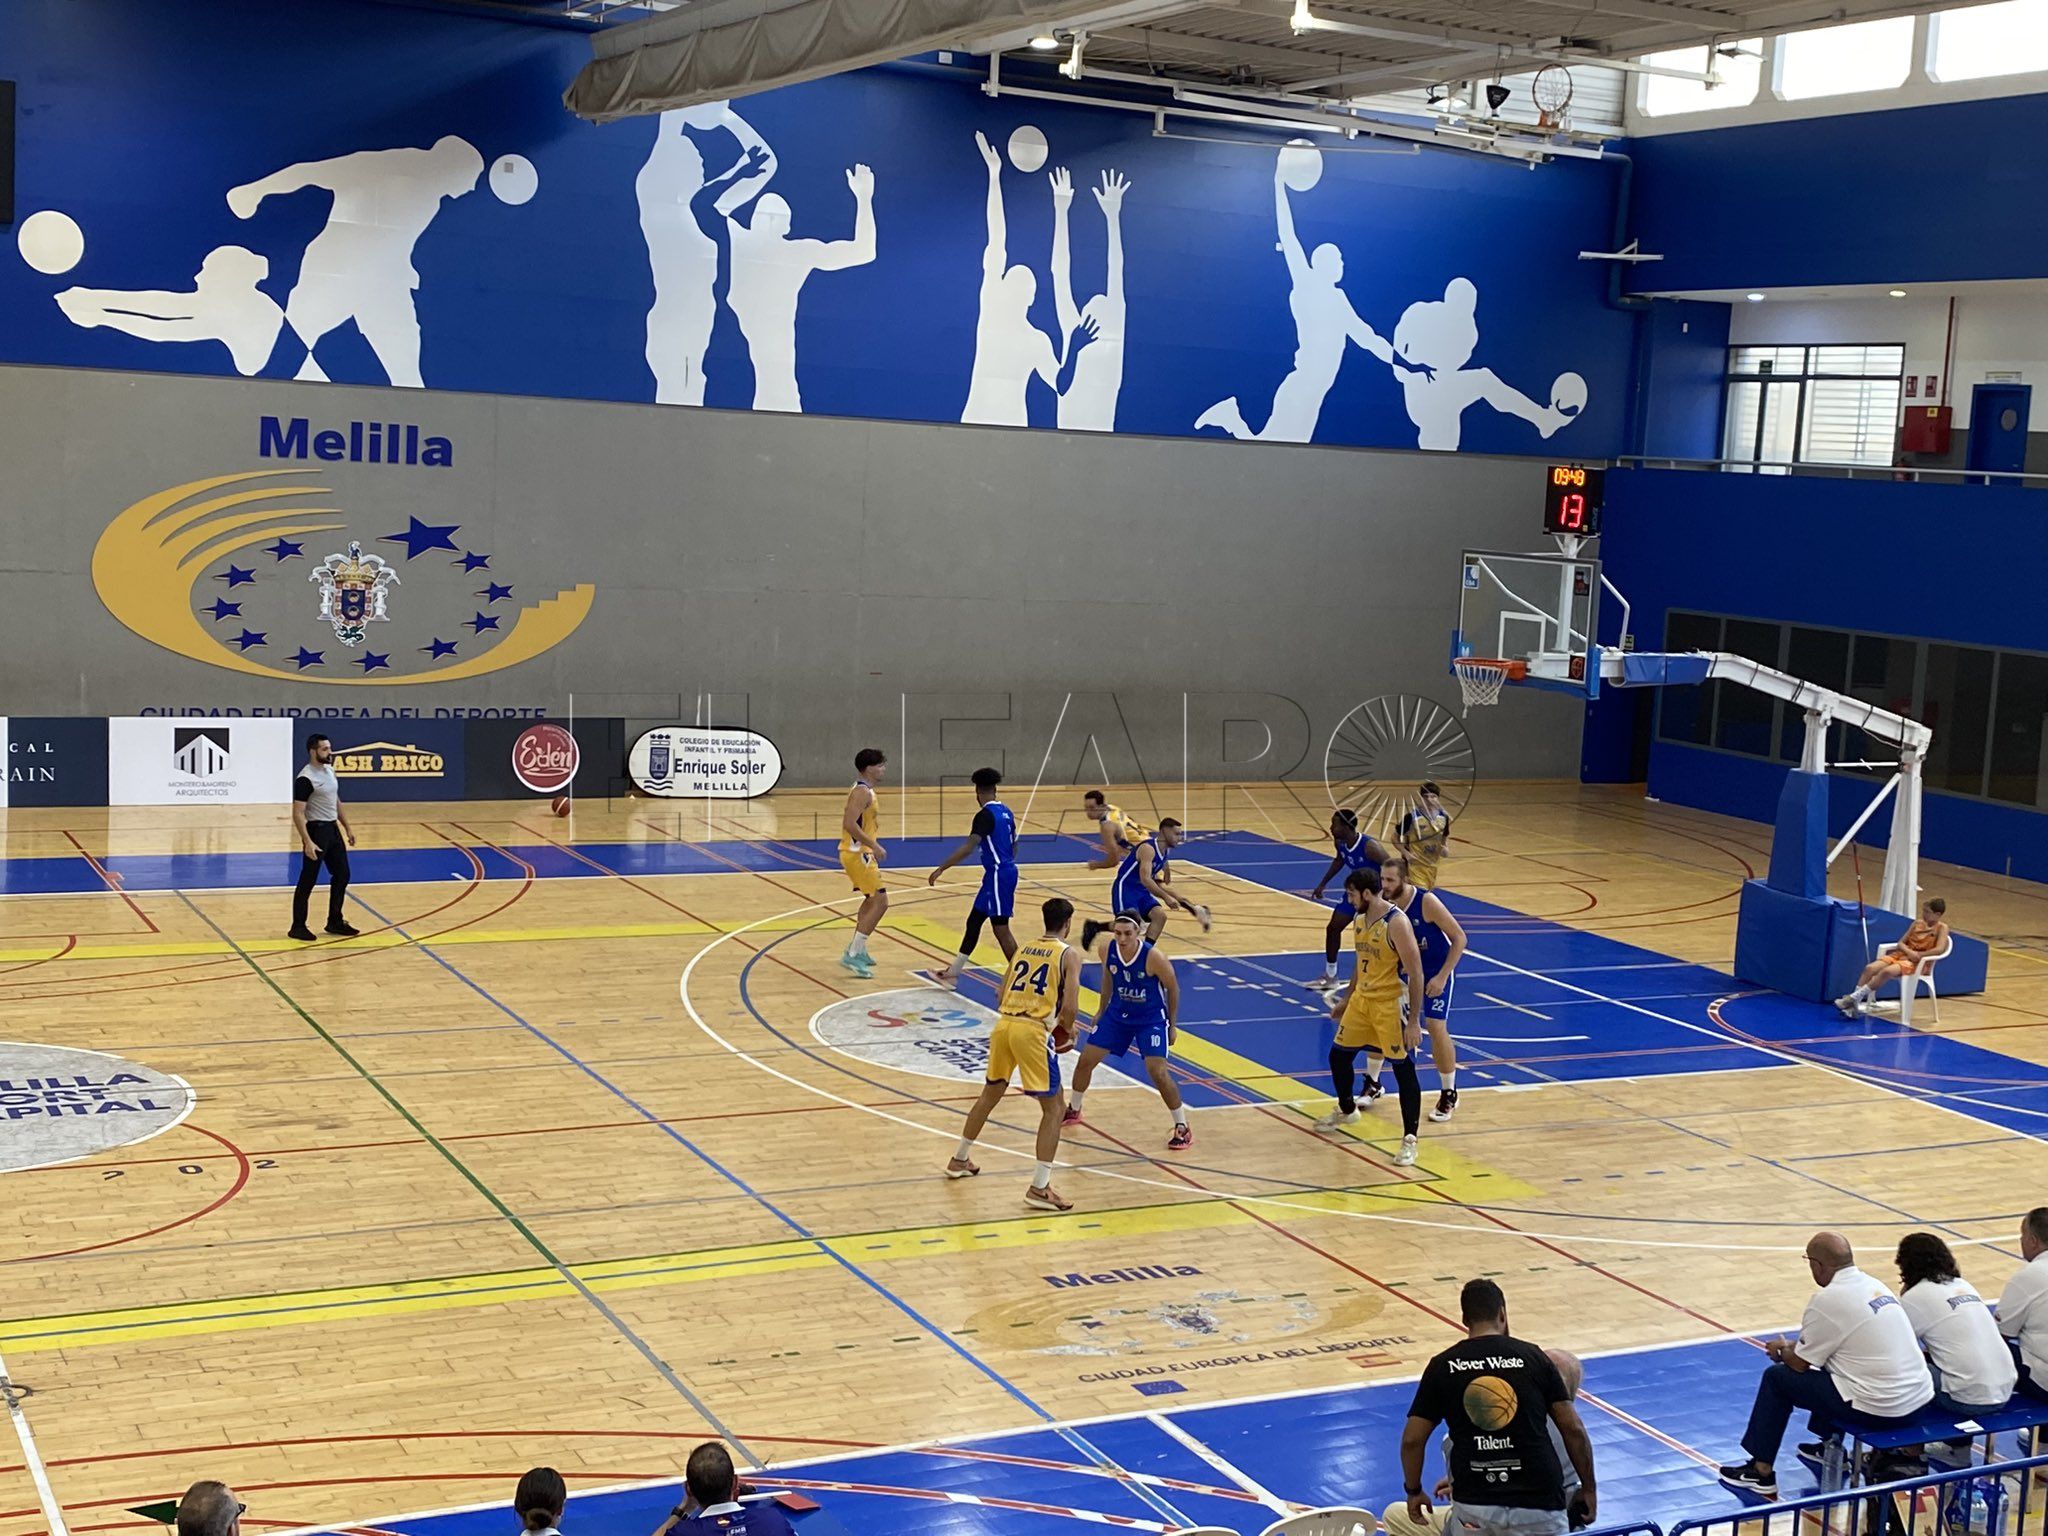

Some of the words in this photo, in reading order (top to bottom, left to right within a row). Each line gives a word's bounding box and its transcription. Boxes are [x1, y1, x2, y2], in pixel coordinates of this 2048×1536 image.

[260, 416, 453, 467] Melilla
[1561, 494, 1584, 528] 13
[9, 742, 54, 753] CAL
[679, 737, 709, 745] COLEGIO
[711, 738, 720, 746] DE
[684, 746, 716, 754] INFANTIL
[332, 755, 373, 771] ASH
[380, 754, 444, 771] BRICO
[674, 757, 727, 778] Enrique
[730, 759, 766, 775] Soler
[693, 782, 748, 791] MELILLA
[1021, 946, 1053, 958] JUANLU
[1361, 959, 1369, 973] 7
[1010, 960, 1049, 996] 24
[1431, 998, 1445, 1012] 22
[1151, 1034, 1160, 1047] 10
[0, 1098, 171, 1119] PITAL
[1043, 1265, 1203, 1288] Melilla
[1078, 1366, 1166, 1383] CIUDAD
[1165, 1353, 1274, 1373] EUROPEA
[1273, 1348, 1317, 1358] DEL
[1317, 1335, 1416, 1353] DEPORTE
[1448, 1358, 1485, 1373] Never
[1486, 1356, 1524, 1369] Waste
[1474, 1435, 1514, 1450] Talent.
